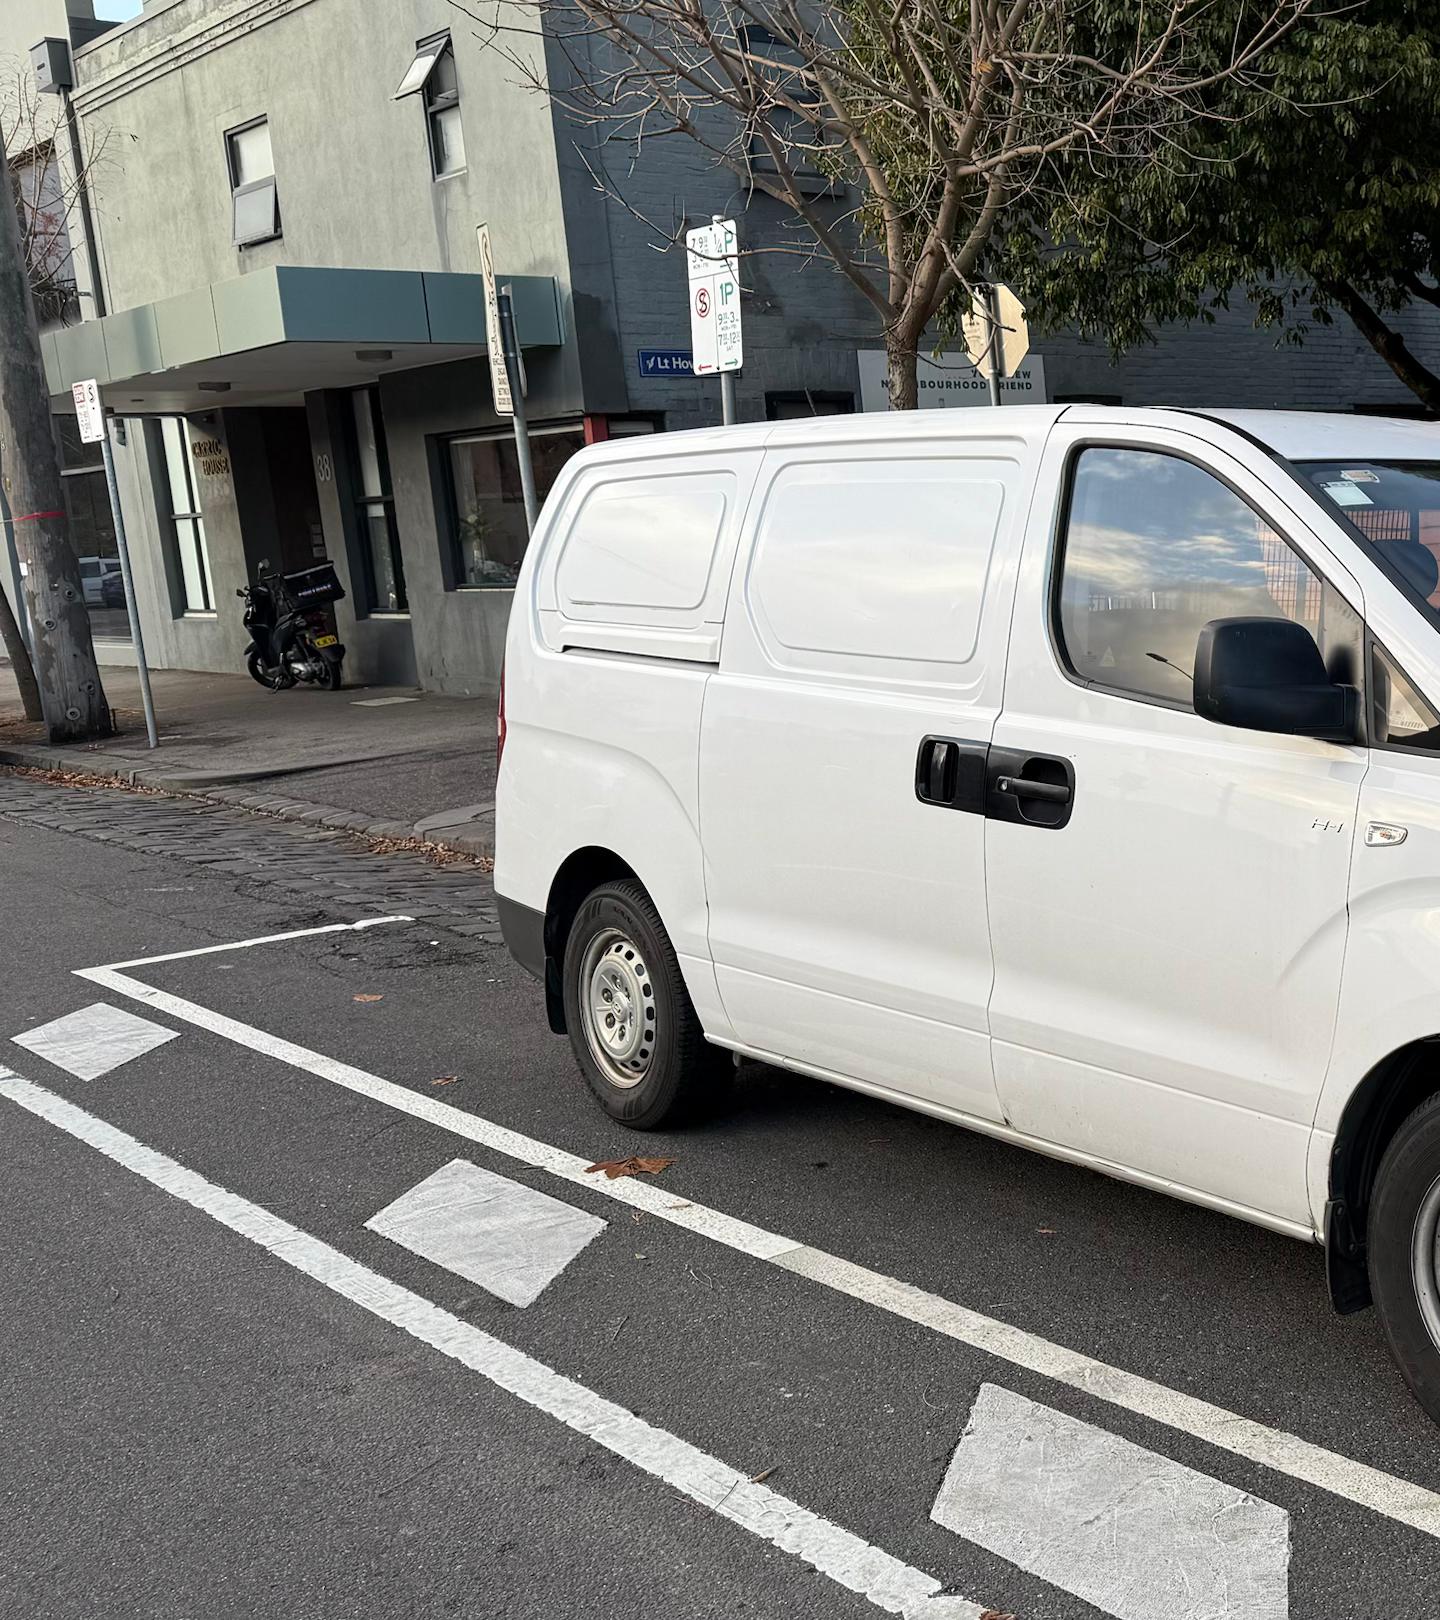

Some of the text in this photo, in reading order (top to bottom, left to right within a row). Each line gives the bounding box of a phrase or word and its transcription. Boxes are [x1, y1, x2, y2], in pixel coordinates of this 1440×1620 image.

[720, 282, 734, 305] 1P
[657, 356, 670, 369] Lt
[999, 381, 1032, 390] RIEND
[317, 454, 331, 481] 38
